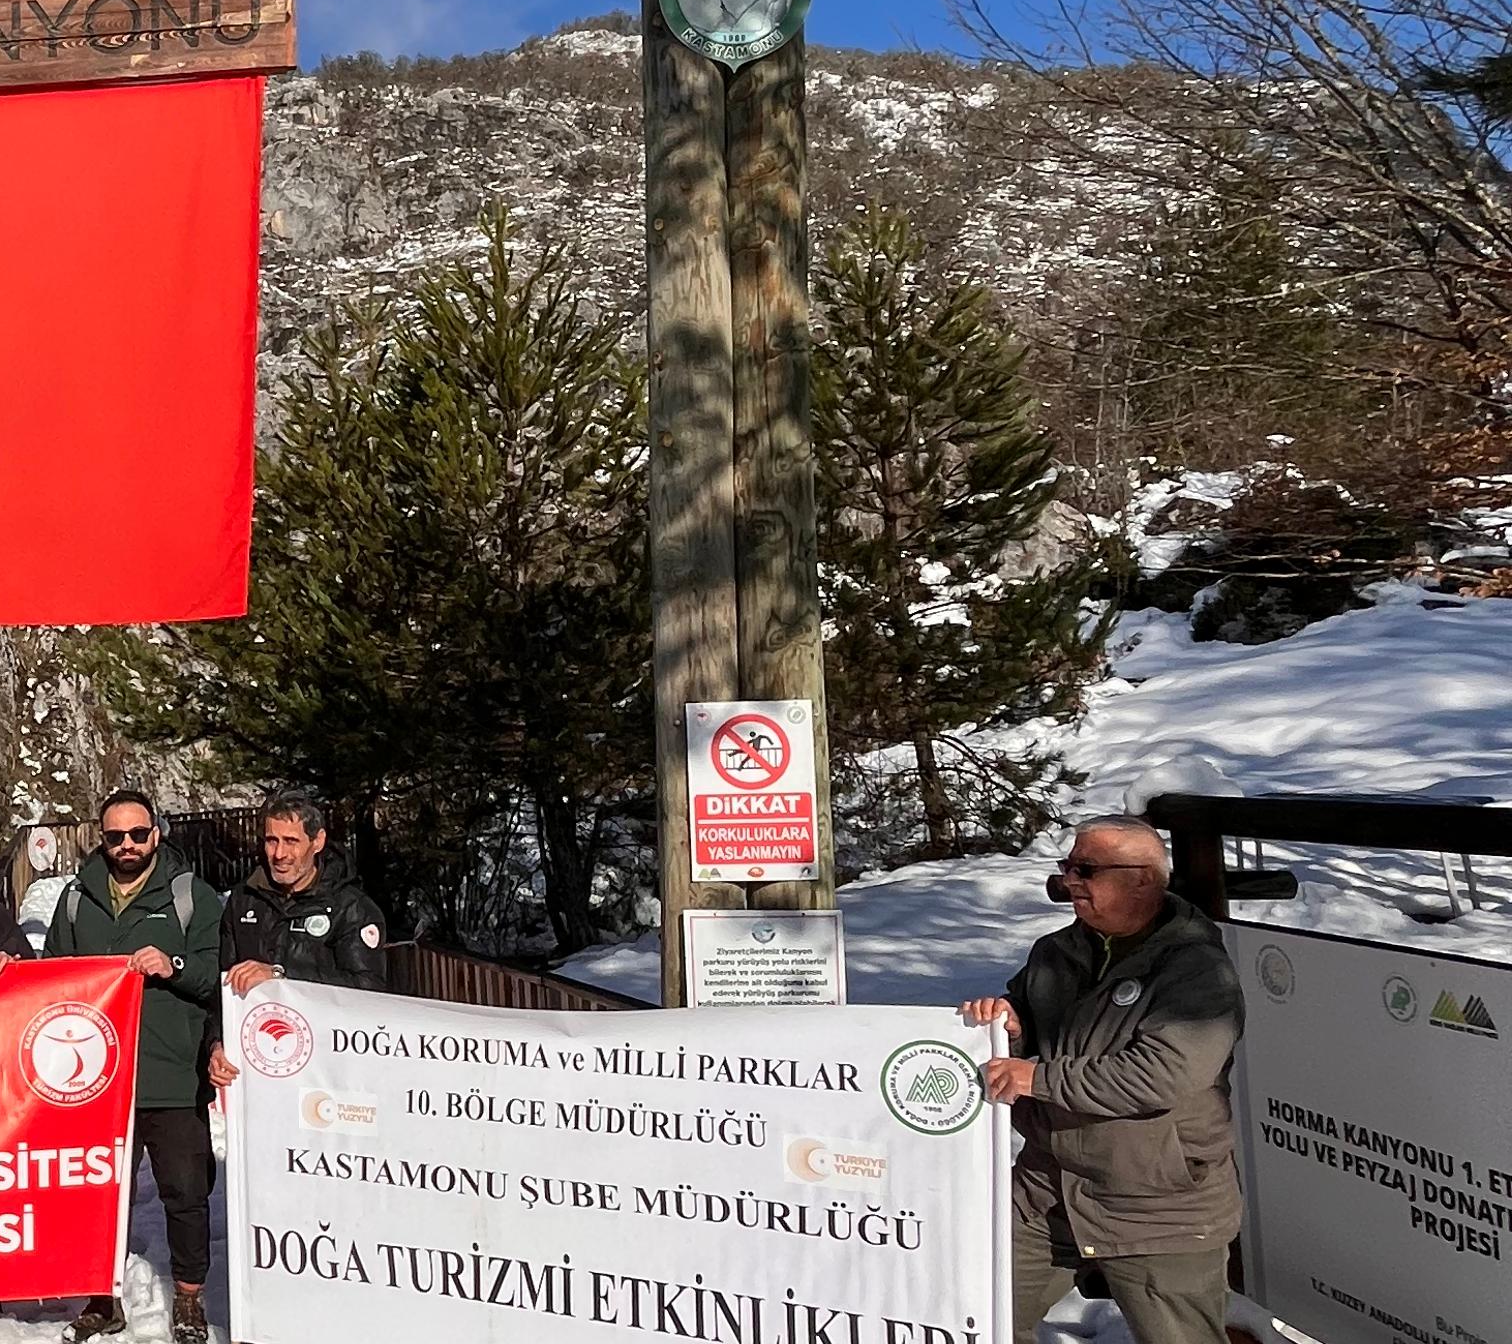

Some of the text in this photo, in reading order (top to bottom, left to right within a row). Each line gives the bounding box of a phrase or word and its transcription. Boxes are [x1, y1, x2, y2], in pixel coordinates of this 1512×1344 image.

[681, 27, 784, 60] KASTAMONU
[698, 826, 811, 843] KORKULUKLARA
[708, 845, 802, 861] YASLANMAYIN
[332, 1024, 411, 1058] DOĞA
[419, 1034, 550, 1069] KORUMA
[558, 1052, 585, 1072] ve
[593, 1042, 687, 1080] MİLLİ
[696, 1053, 863, 1093] PARKLAR
[405, 1088, 767, 1148] 10. BÖLGE MÜDÜRLÜĞÜ
[1267, 1097, 1341, 1140] HORMA
[1343, 1121, 1454, 1177] KANYONU
[1461, 1161, 1482, 1188] 1.
[1260, 1121, 1309, 1157] YOLU
[1313, 1140, 1338, 1168] VE
[1342, 1151, 1416, 1203] PEYZAJ
[286, 1147, 926, 1251] KASTAMONU ŞUBE MÜDÜRLÜĞÜ
[1410, 1205, 1501, 1261] PROJESİ
[250, 1220, 372, 1284] DOĞA
[377, 1242, 576, 1318] TURİZMİ
